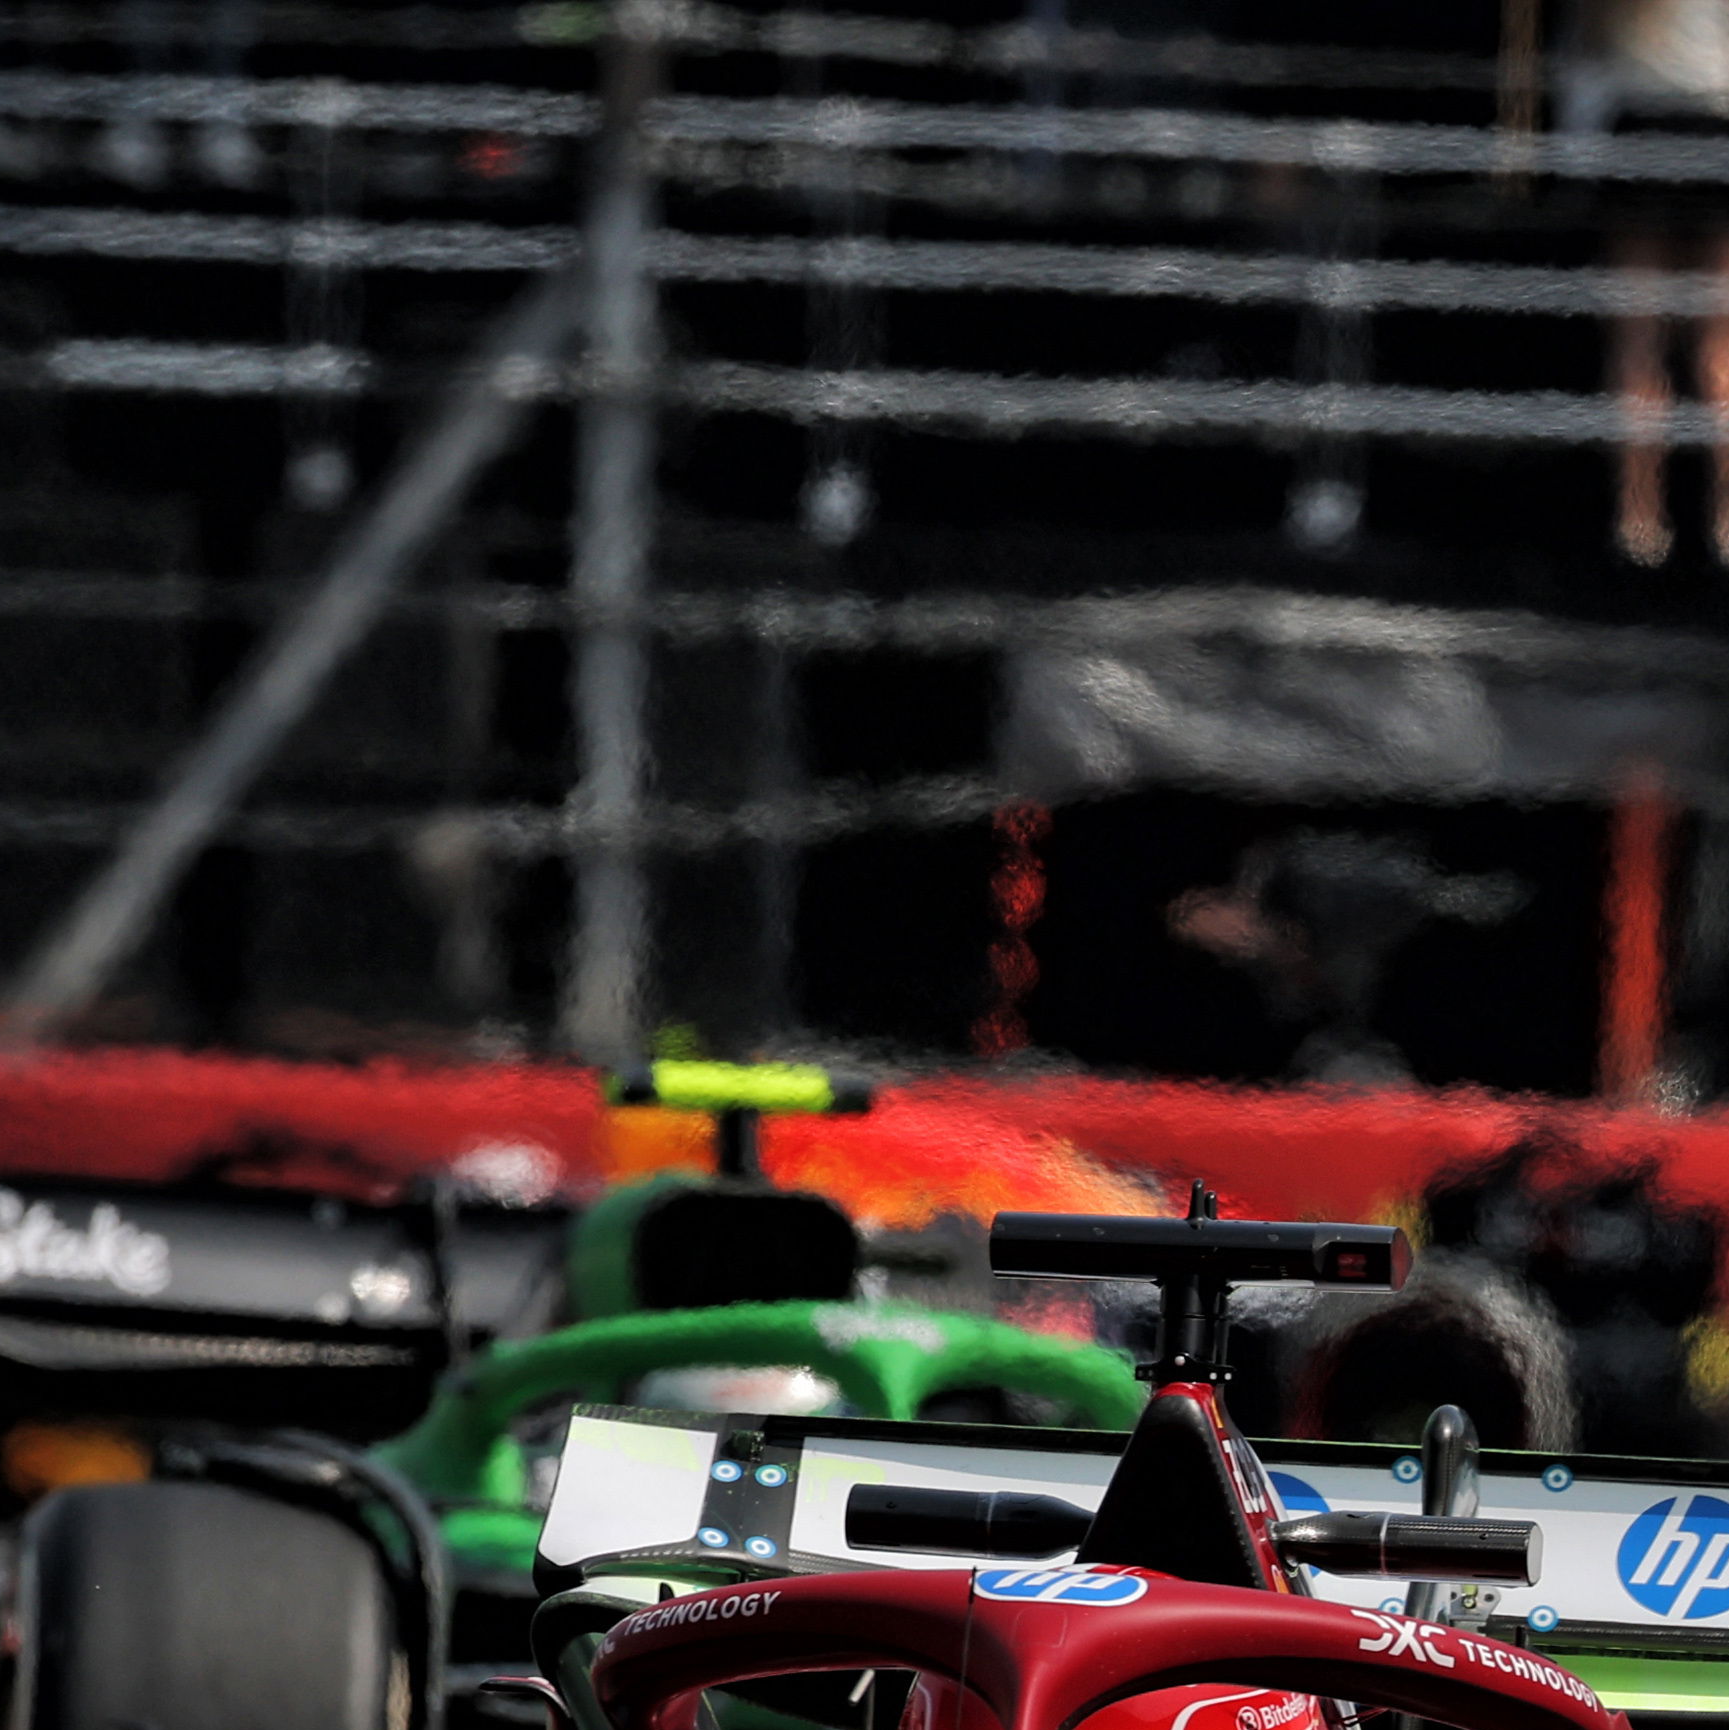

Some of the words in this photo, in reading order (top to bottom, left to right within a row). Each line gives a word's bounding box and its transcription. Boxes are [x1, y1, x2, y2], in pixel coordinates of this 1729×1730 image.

[624, 1591, 782, 1636] TECHNOLOGY
[1351, 1609, 1456, 1669] DXC
[1458, 1639, 1600, 1713] TECHNOLOGY
